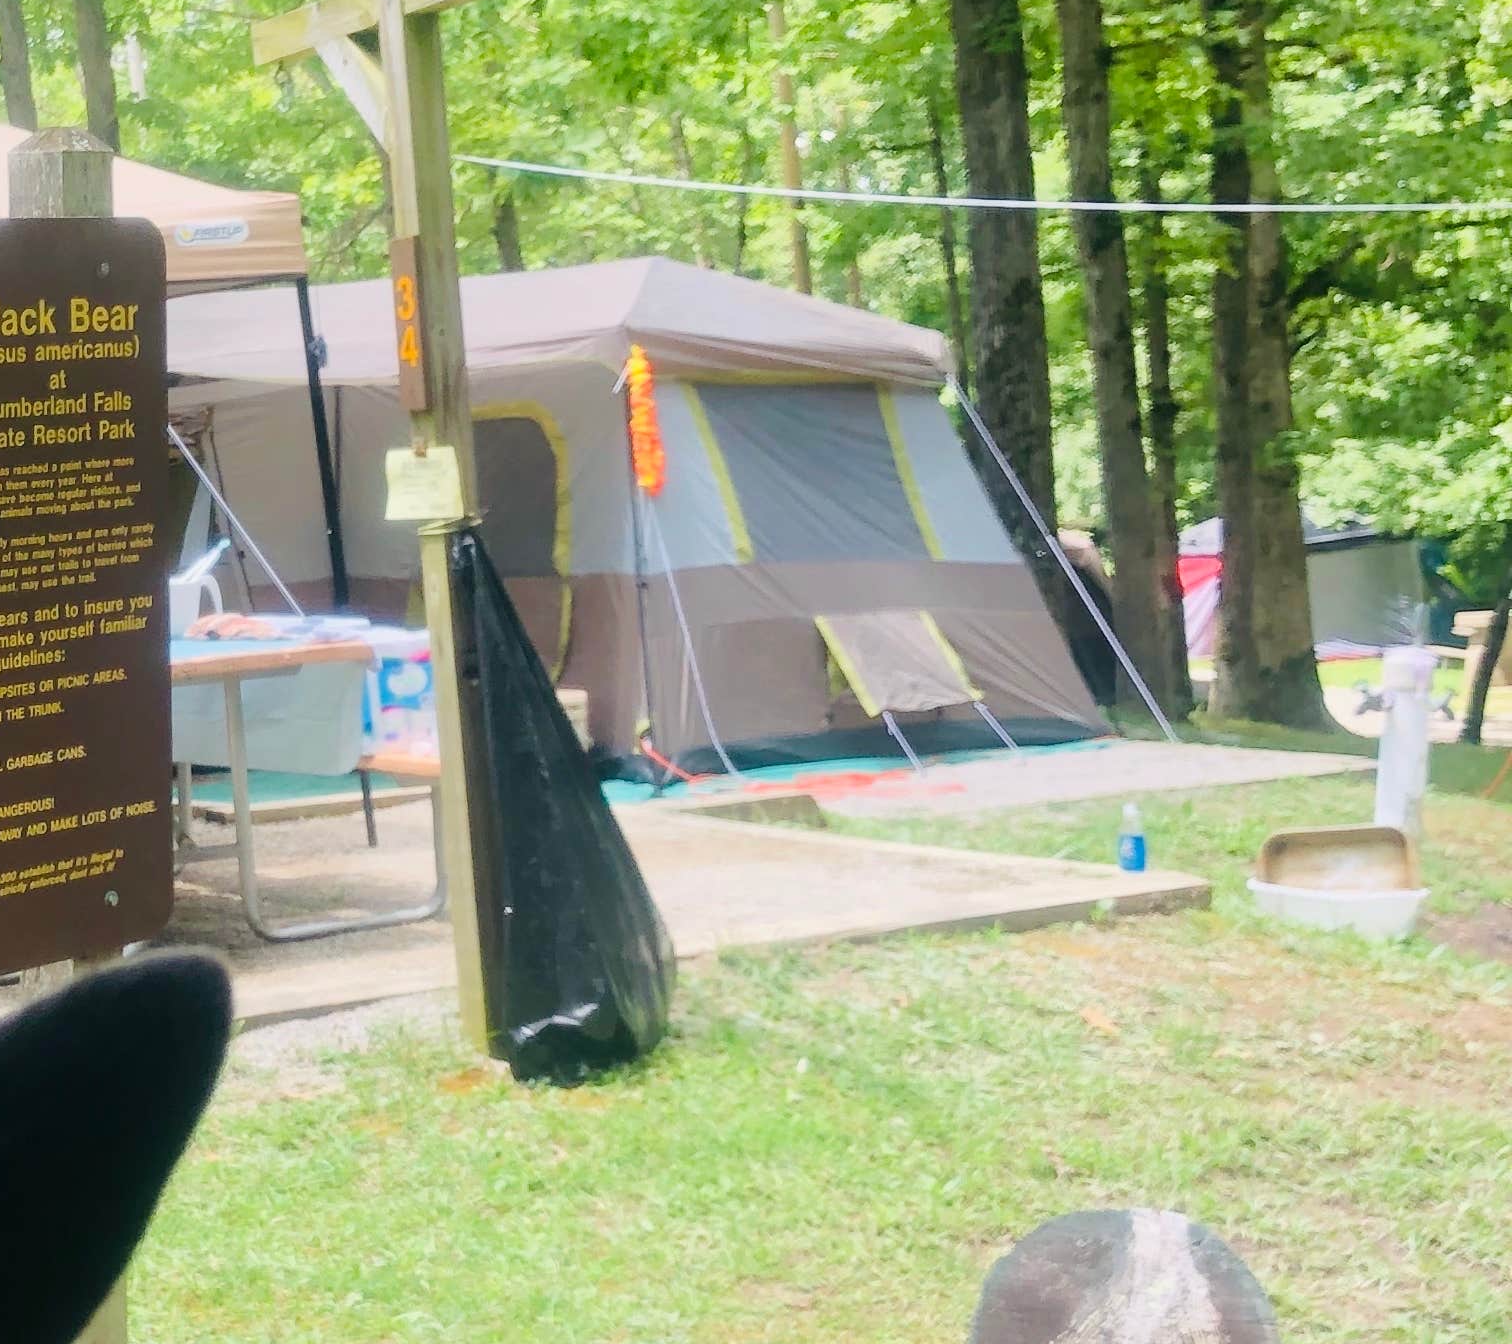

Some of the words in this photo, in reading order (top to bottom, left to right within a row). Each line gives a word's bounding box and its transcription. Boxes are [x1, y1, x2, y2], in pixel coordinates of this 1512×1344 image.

[70, 297, 139, 333] Bear
[35, 335, 140, 362] americanus)
[48, 369, 67, 391] at
[93, 391, 133, 413] Falls
[33, 422, 92, 446] Resort
[98, 419, 136, 441] Park
[34, 606, 60, 622] and
[64, 605, 79, 618] to
[83, 599, 124, 615] insure
[129, 597, 153, 617] you
[40, 622, 95, 646] yourself
[100, 616, 147, 634] familiar
[38, 679, 54, 693] OR
[57, 673, 90, 689] PICNIC
[92, 668, 128, 684] AREAS.
[5, 706, 26, 721] THE
[28, 701, 65, 717] TRUNK.
[6, 751, 54, 770] GARBAGE
[56, 745, 87, 761] CANS.
[26, 822, 48, 837] AND
[50, 815, 79, 832] MAKE
[81, 810, 107, 826] LOTS
[109, 806, 124, 820] OF
